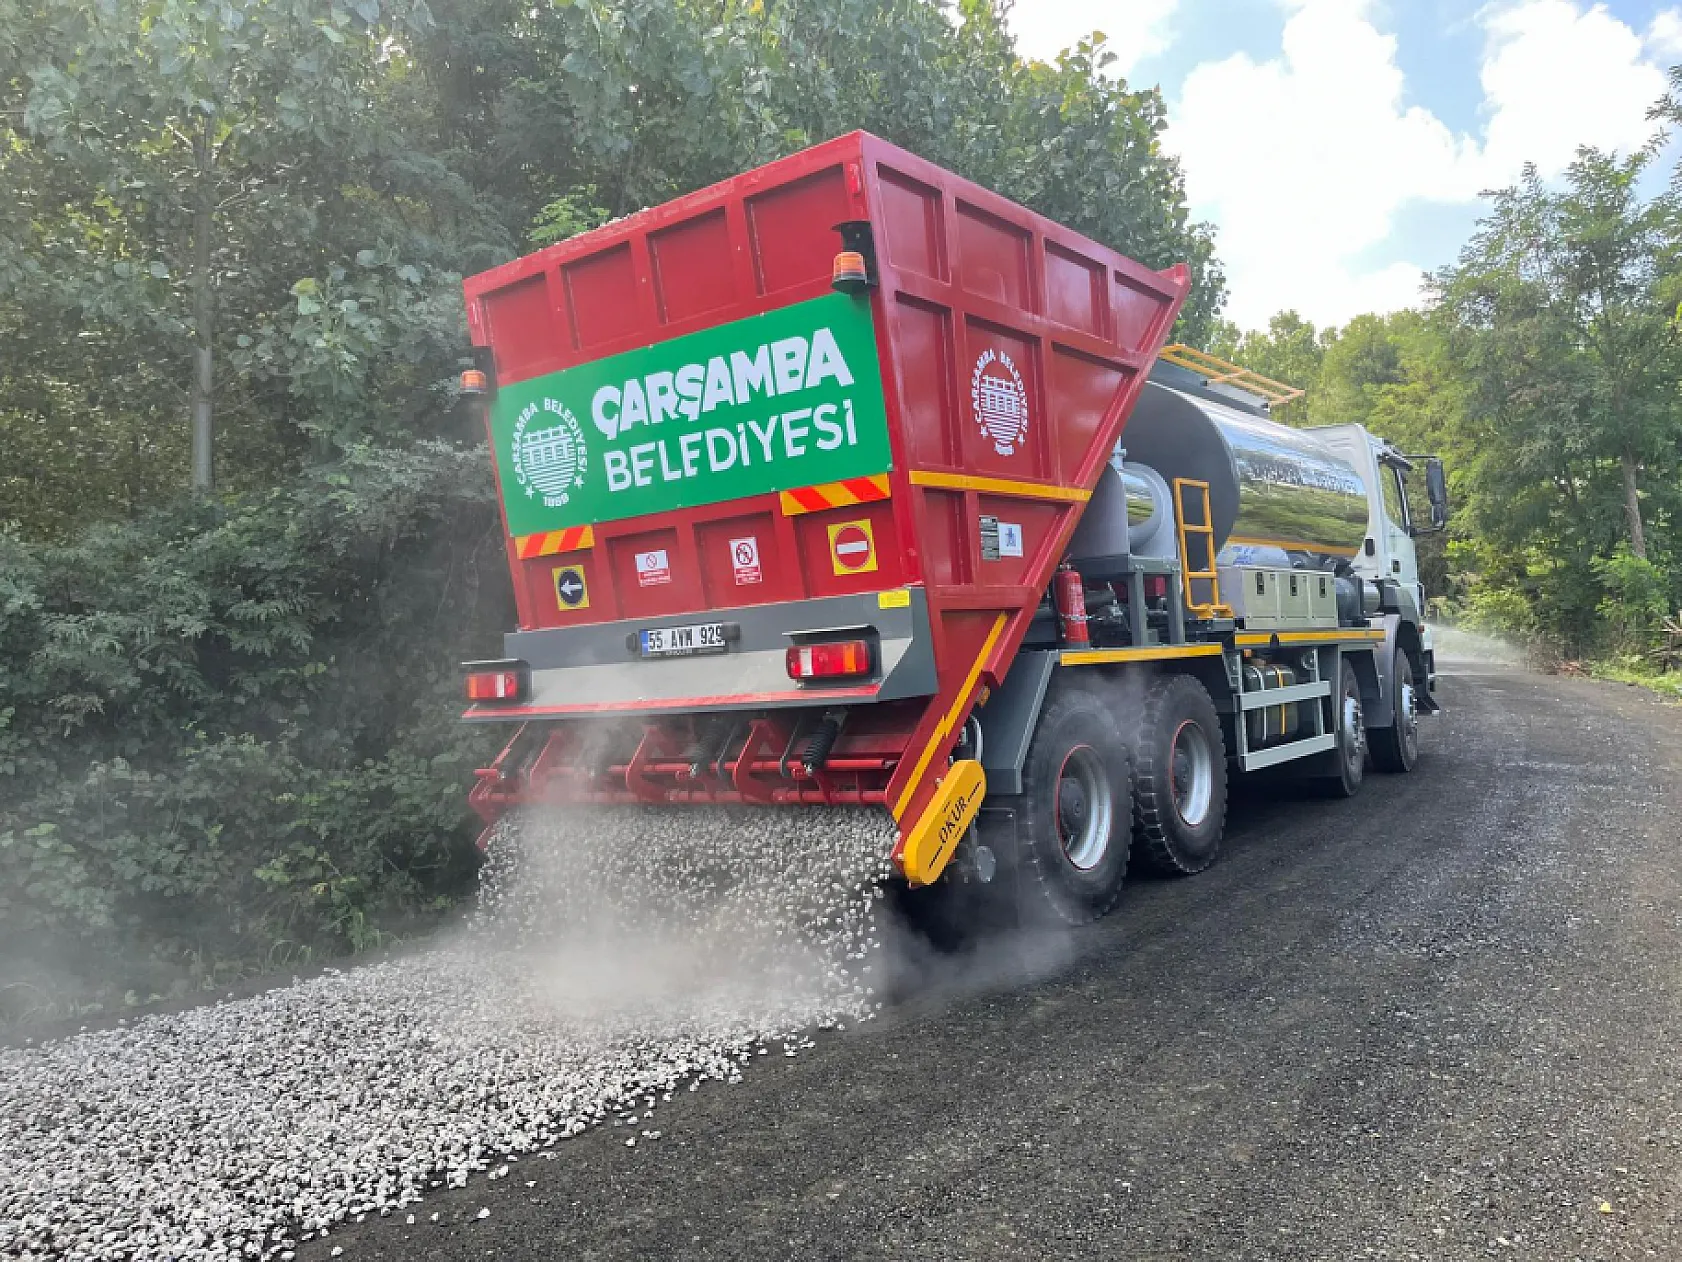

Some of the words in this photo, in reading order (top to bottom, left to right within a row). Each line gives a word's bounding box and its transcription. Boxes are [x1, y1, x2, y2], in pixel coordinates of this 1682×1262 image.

[591, 327, 854, 440] ÇARŞAMBA
[604, 399, 858, 492] BELEDİYESİ
[648, 630, 663, 650] 55
